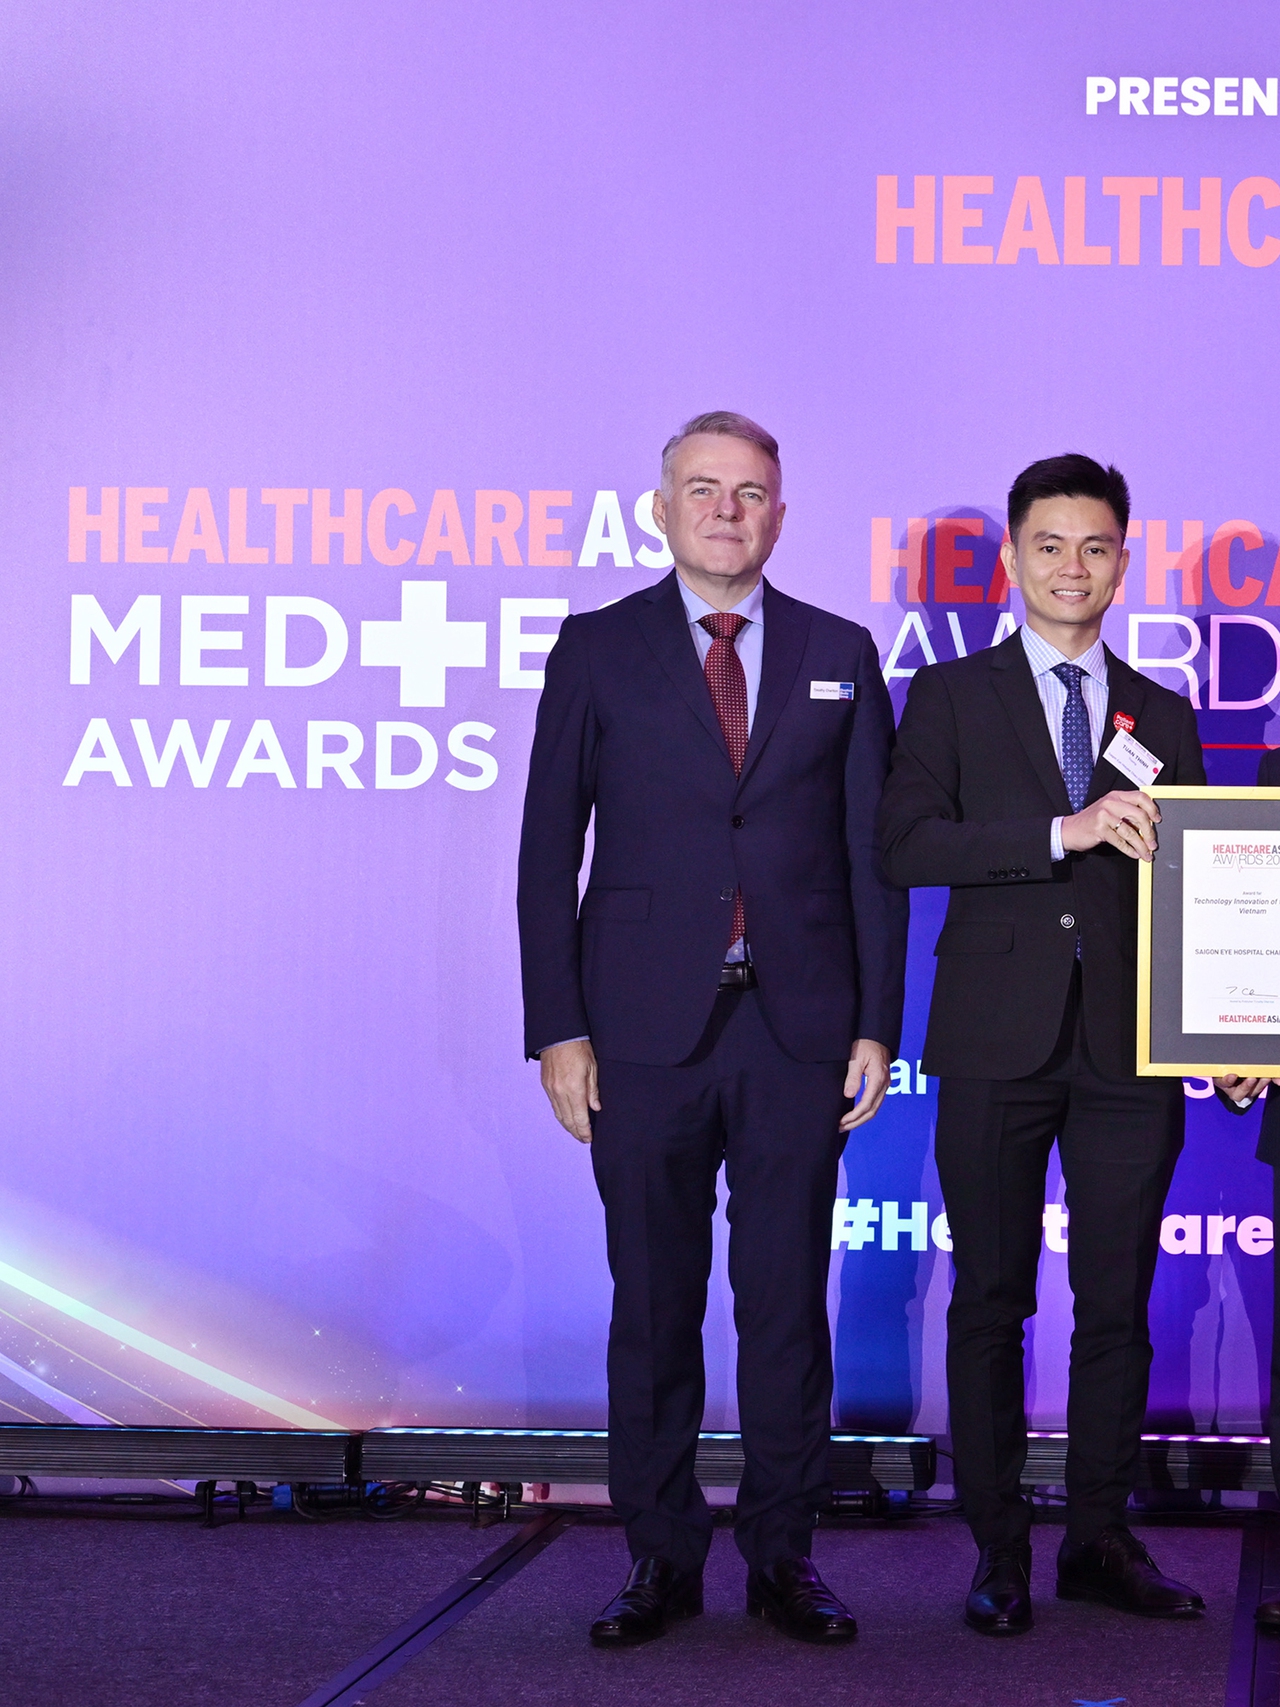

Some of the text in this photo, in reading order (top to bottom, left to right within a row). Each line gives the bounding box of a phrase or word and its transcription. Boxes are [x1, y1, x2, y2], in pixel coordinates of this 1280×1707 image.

[68, 486, 676, 569] HEALTHCARE AS
[62, 717, 499, 791] AWARDS
[1194, 897, 1233, 906] Technology
[1239, 907, 1267, 915] Vietnam
